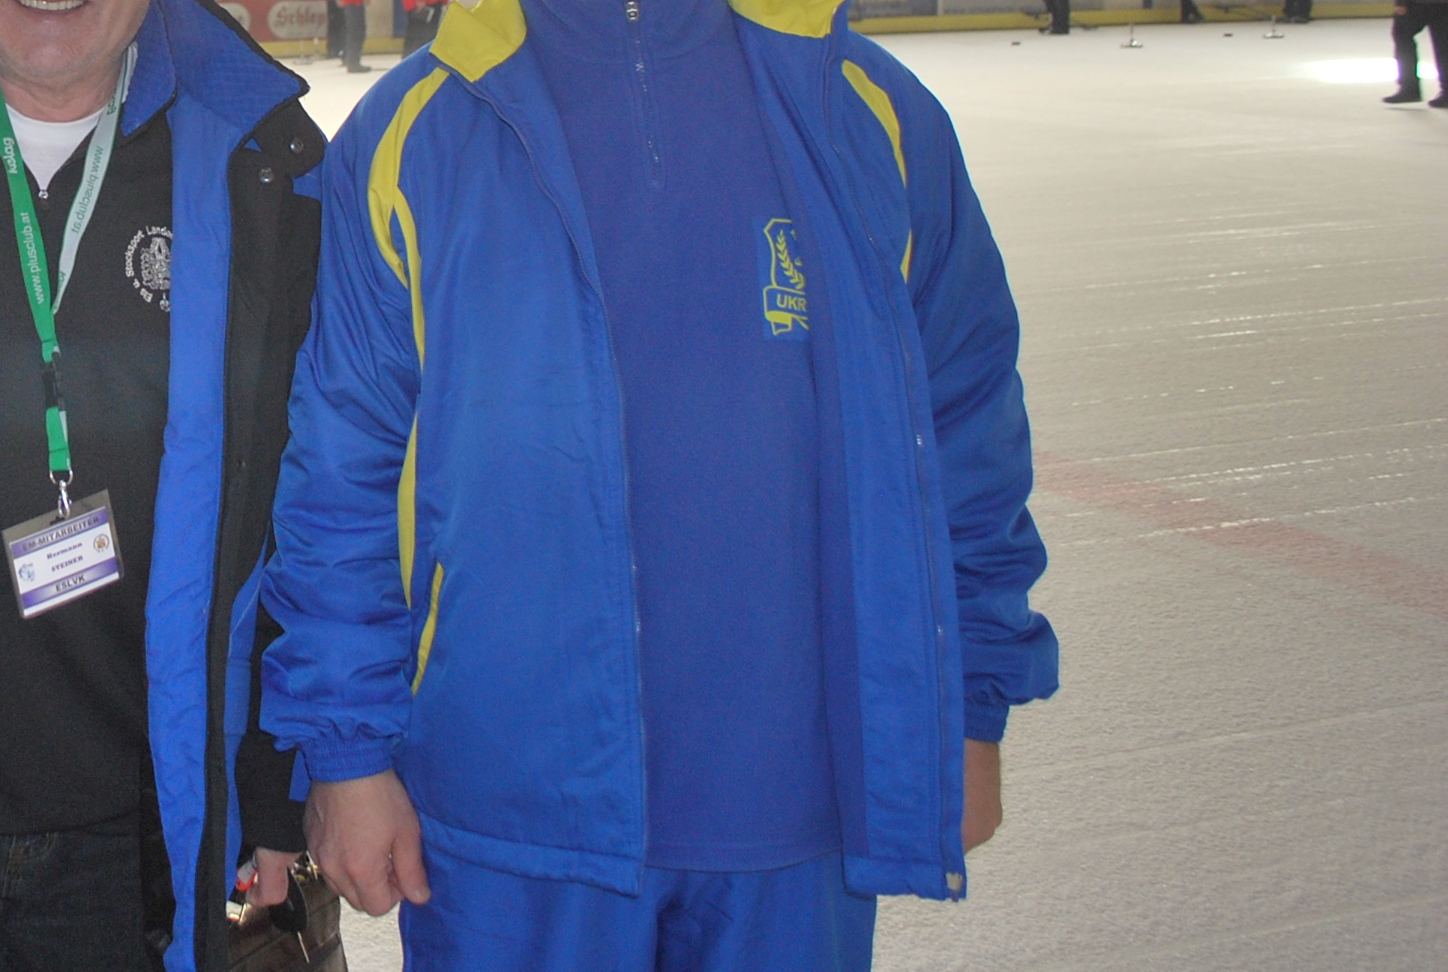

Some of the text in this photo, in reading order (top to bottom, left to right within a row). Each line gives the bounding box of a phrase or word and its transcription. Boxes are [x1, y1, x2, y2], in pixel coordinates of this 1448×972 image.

[3, 137, 19, 174] kelag
[20, 211, 46, 306] www.plusclub.at
[22, 515, 100, 552] EM-MITARBEITER
[55, 575, 86, 593] ESLVK
